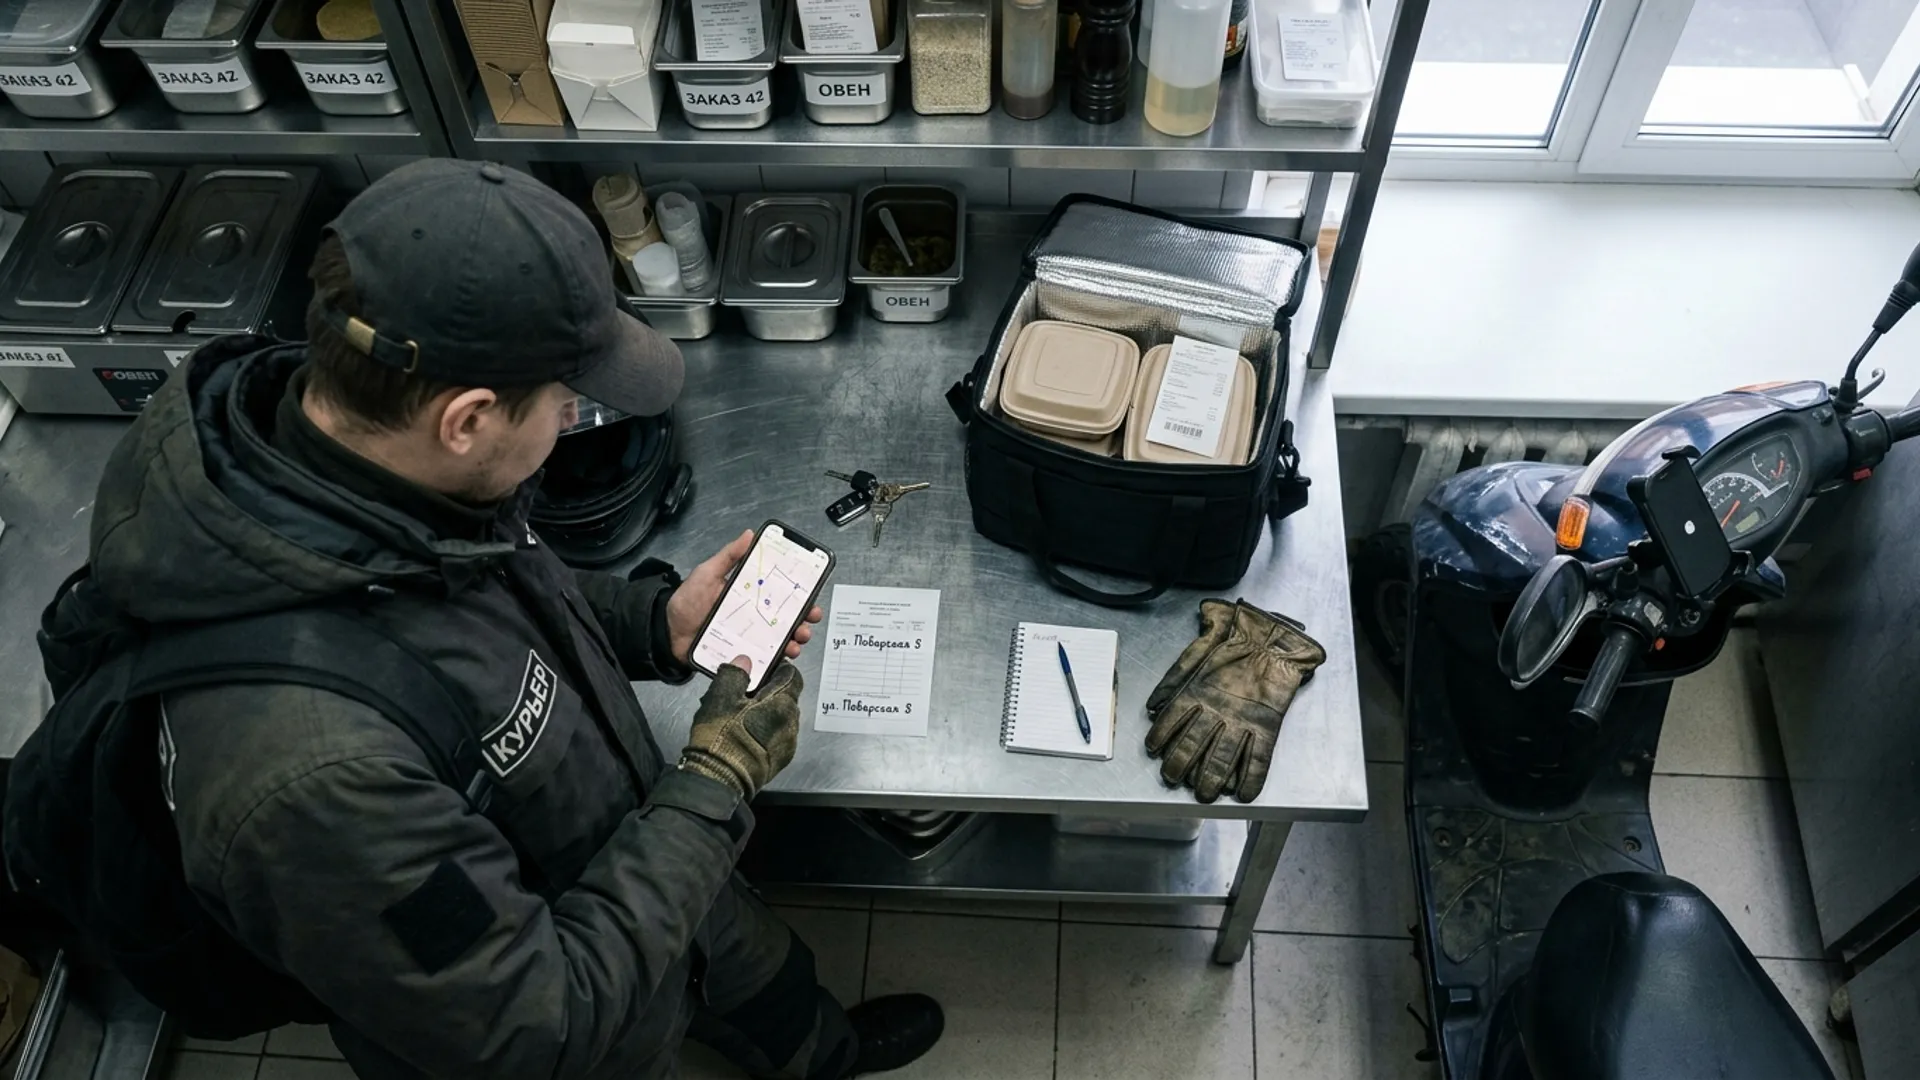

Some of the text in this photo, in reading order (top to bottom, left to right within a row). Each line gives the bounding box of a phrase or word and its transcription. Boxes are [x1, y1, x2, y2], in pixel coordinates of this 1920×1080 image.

[158, 71, 214, 84] ЗАКАЗ
[304, 71, 361, 85] ЗАКАЗ
[818, 83, 871, 97] ОВЕН
[685, 89, 765, 106] ЗАКАЗ 42
[885, 296, 930, 307] ОВЕН
[491, 663, 549, 763] КУРЬЕР
